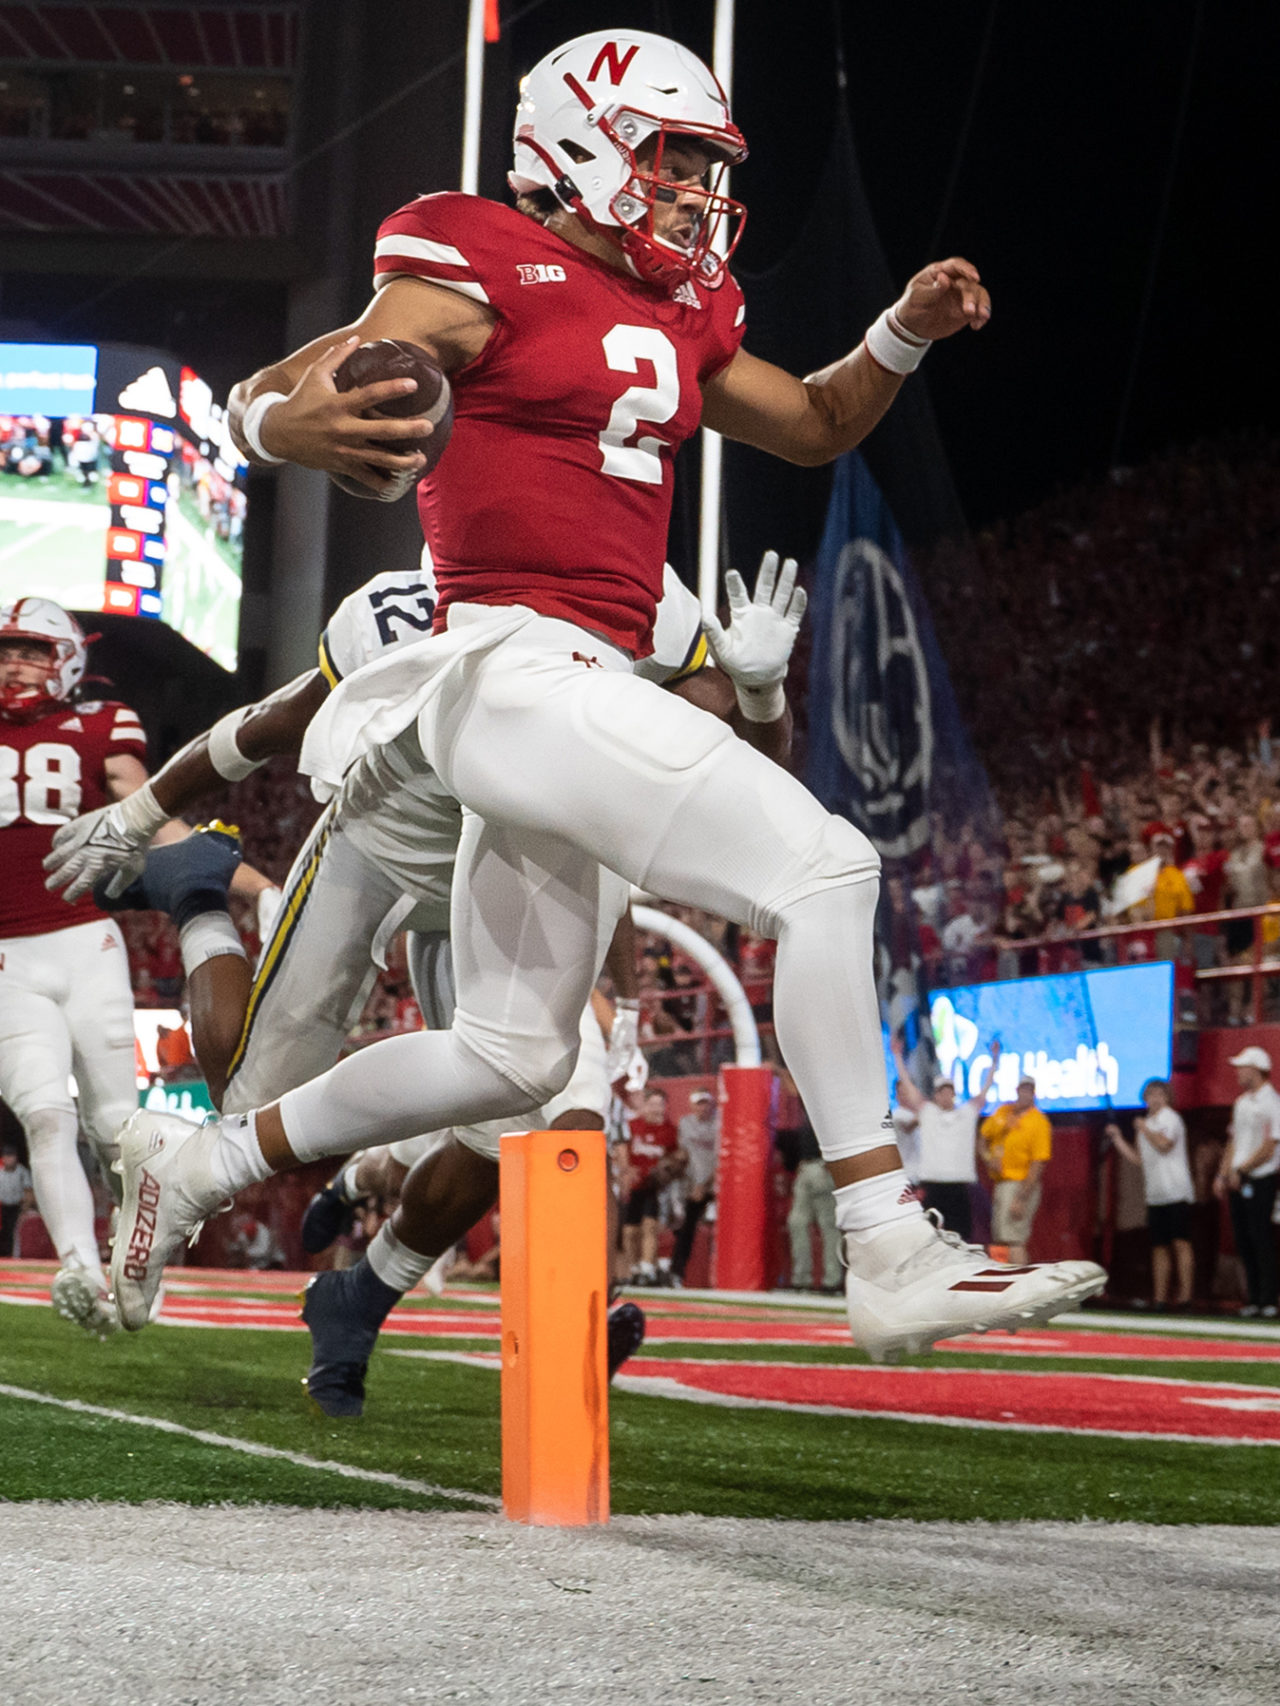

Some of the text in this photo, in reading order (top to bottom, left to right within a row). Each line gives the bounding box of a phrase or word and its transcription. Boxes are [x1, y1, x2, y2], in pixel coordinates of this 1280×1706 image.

[587, 42, 640, 86] N
[599, 324, 680, 485] 2
[368, 584, 436, 647] 12
[1023, 1042, 1118, 1099] Health
[123, 1167, 161, 1282] ADIZERO
